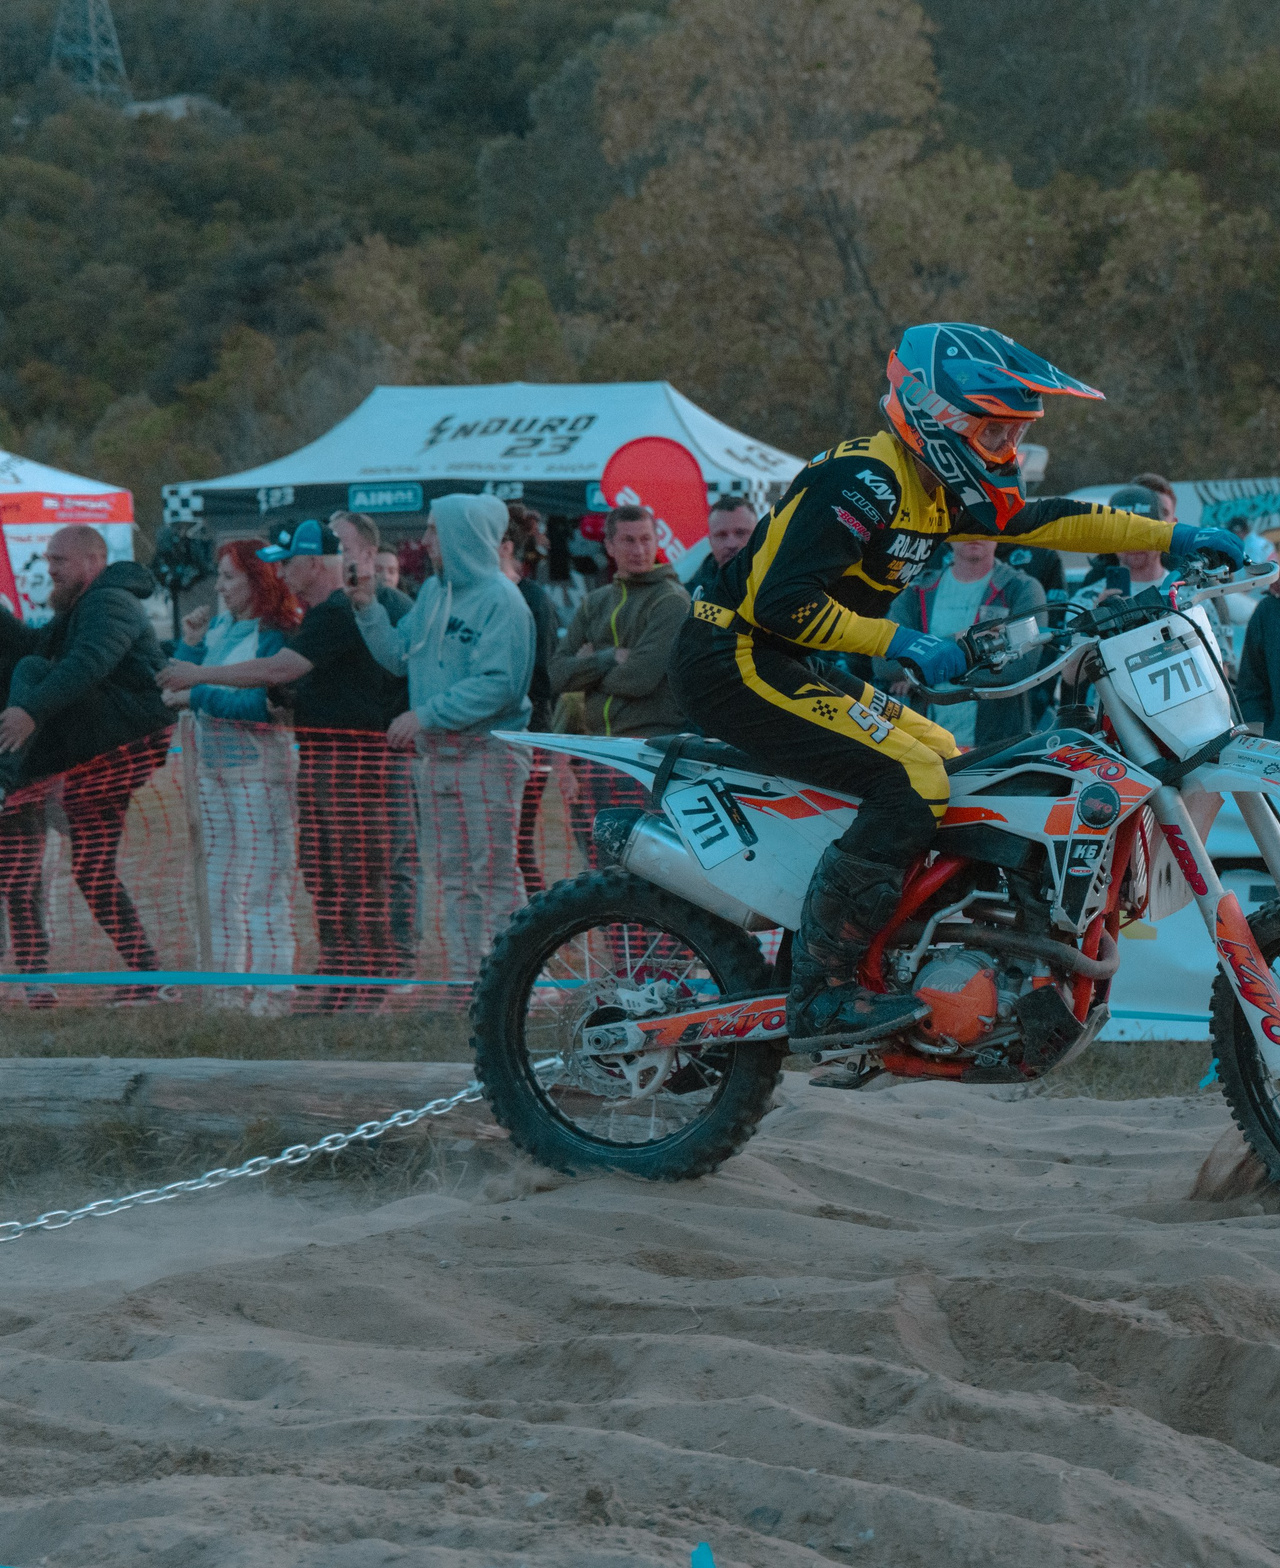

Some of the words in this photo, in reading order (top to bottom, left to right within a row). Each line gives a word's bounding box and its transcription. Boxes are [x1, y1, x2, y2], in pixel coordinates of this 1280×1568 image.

[900, 375, 970, 432] 100%
[500, 434, 579, 459] 23
[907, 634, 944, 656] FLY
[1147, 657, 1203, 702] 711
[1044, 745, 1128, 781] KAYO
[681, 796, 730, 850] 711
[1073, 844, 1099, 859] K6
[696, 1002, 786, 1041] KAYO
